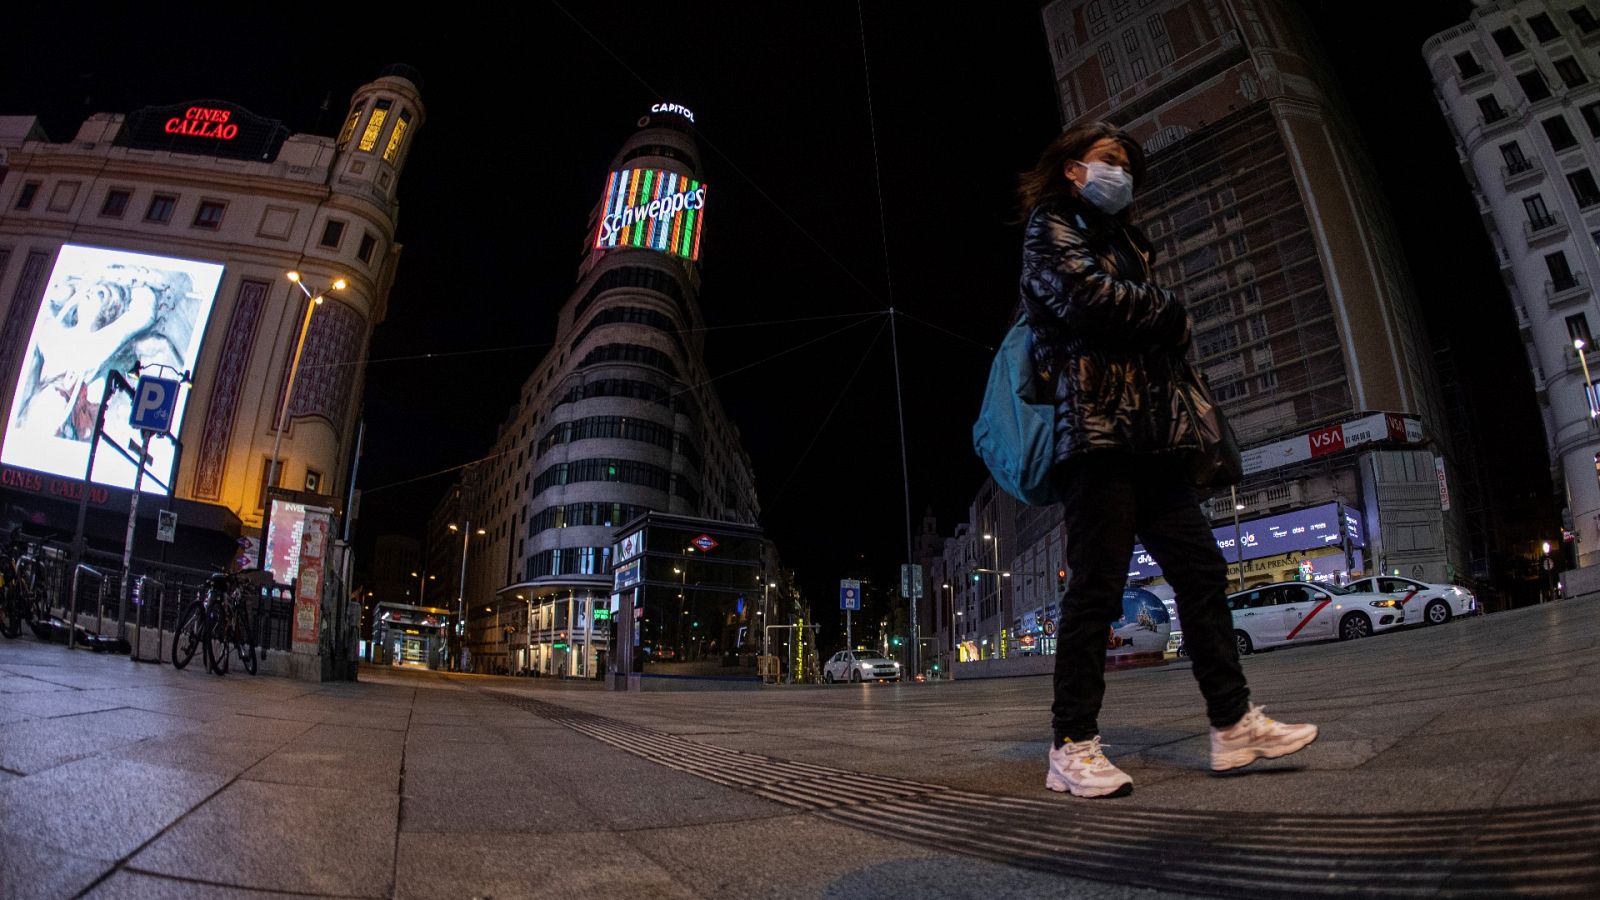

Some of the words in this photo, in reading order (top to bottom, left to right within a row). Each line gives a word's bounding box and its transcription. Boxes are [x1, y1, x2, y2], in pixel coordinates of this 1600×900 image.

[185, 107, 231, 123] CINES
[651, 102, 695, 122] CAPITOL
[164, 117, 239, 140] CALLAO
[600, 188, 705, 241] Schweppes
[135, 381, 166, 422] P
[1312, 430, 1341, 448] VSA
[1, 468, 42, 491] CINES
[1255, 562, 1266, 571] LA
[1267, 556, 1298, 569] PRENSA
